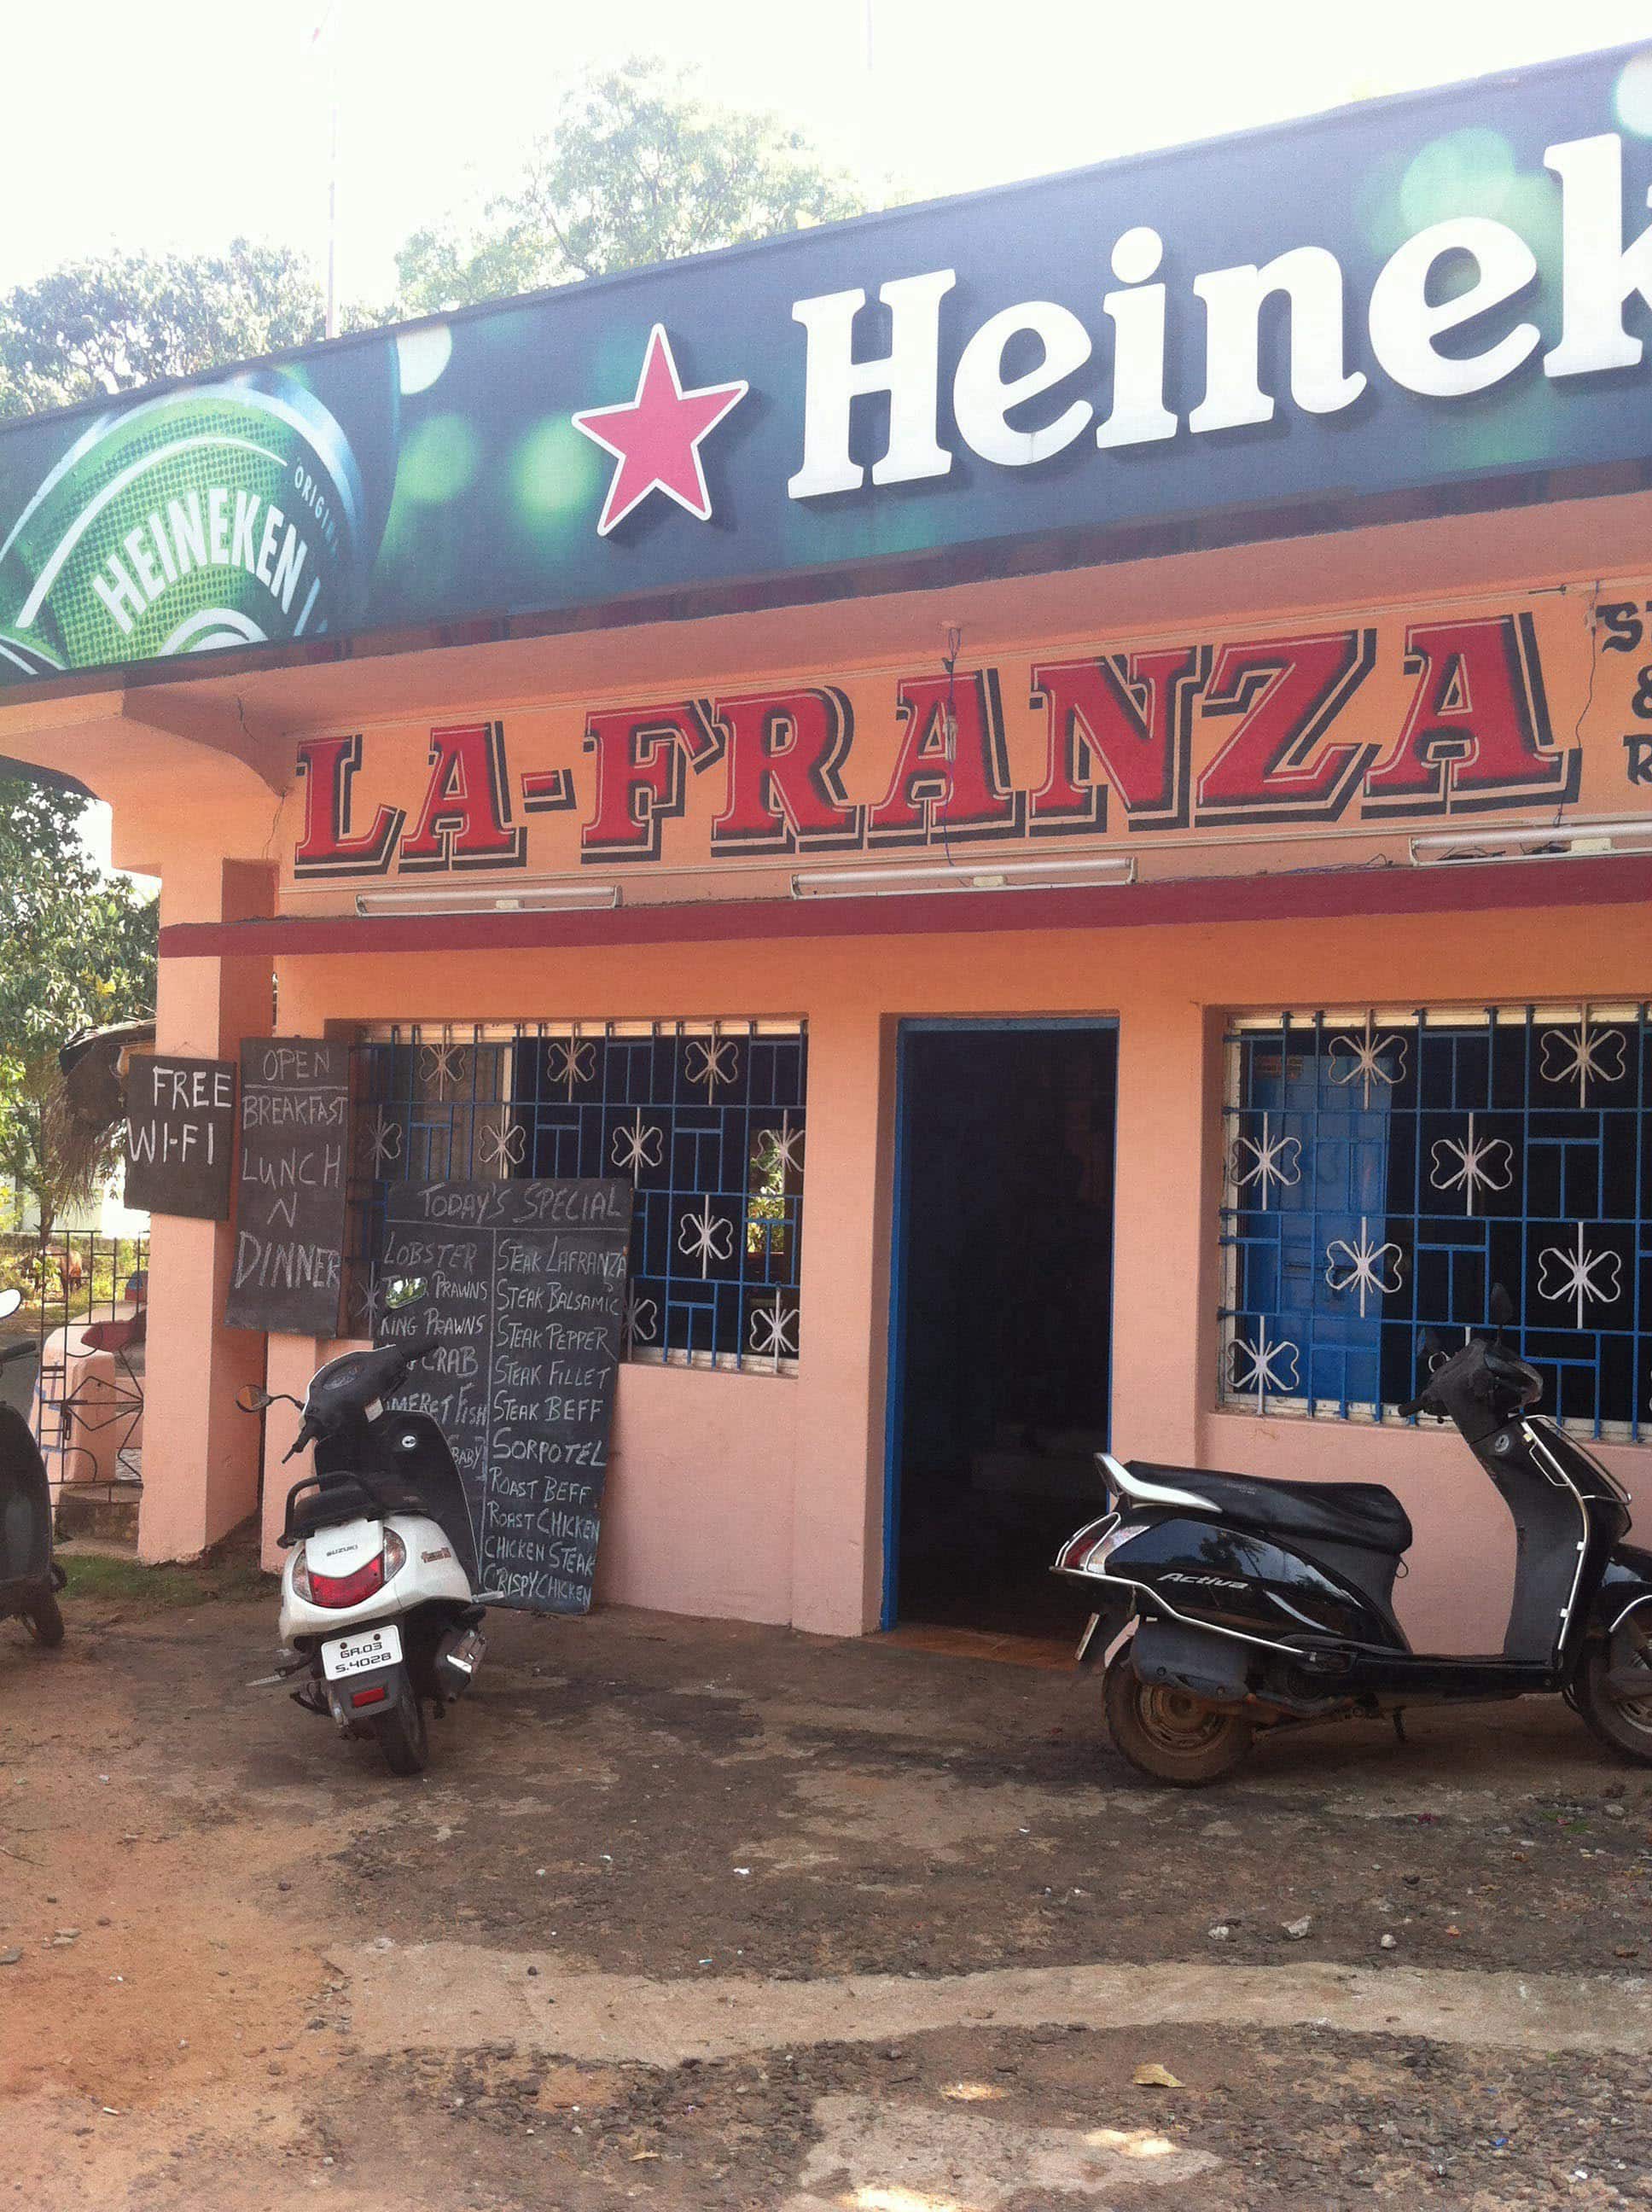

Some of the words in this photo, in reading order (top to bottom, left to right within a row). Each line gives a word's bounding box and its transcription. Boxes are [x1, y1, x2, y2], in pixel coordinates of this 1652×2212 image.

[788, 132, 1652, 499] Heinek
[91, 486, 308, 635] HEINEKEN
[1595, 600, 1652, 654] S
[294, 612, 1582, 880] LA-FRANZA
[262, 1047, 331, 1081] OPEN
[152, 1066, 232, 1110] FREE
[243, 1096, 348, 1130] BREAKFAST
[127, 1117, 213, 1164] WI-FI
[242, 1143, 341, 1190] LUNCH
[266, 1192, 298, 1228] N
[417, 1182, 511, 1224] TODAY'S
[513, 1183, 622, 1224] SPECIAL
[234, 1231, 341, 1289] DINNER
[384, 1231, 478, 1274] LOBSTER
[497, 1238, 541, 1272] STEAK
[545, 1236, 628, 1278] LAFRANZA
[432, 1270, 488, 1301] PRAWNS
[496, 1278, 543, 1311] STEAK
[546, 1282, 620, 1316] BALSAMIC
[422, 1307, 486, 1336] PRAWNS
[496, 1315, 542, 1350] STEAK
[546, 1324, 619, 1363] PEPPER
[422, 1346, 479, 1378] CRAB
[493, 1355, 541, 1386] STEAK
[549, 1360, 611, 1389] FILLET
[455, 1383, 487, 1426] FISH
[493, 1390, 539, 1422] STEAK
[544, 1396, 604, 1422] BEFF
[492, 1427, 608, 1467] SORPOTEL
[489, 1466, 540, 1499] ROAST
[544, 1476, 592, 1505] BEFF
[487, 1501, 535, 1528] ROAST
[537, 1509, 600, 1541] CHICKEN
[484, 1536, 544, 1562] CHICKEN
[549, 1541, 596, 1576] STEAK
[483, 1563, 539, 1595] CRISPY
[535, 1577, 592, 1606] CHICKEN
[1156, 1572, 1249, 1589] Activa
[334, 1652, 392, 1674] S.4028
